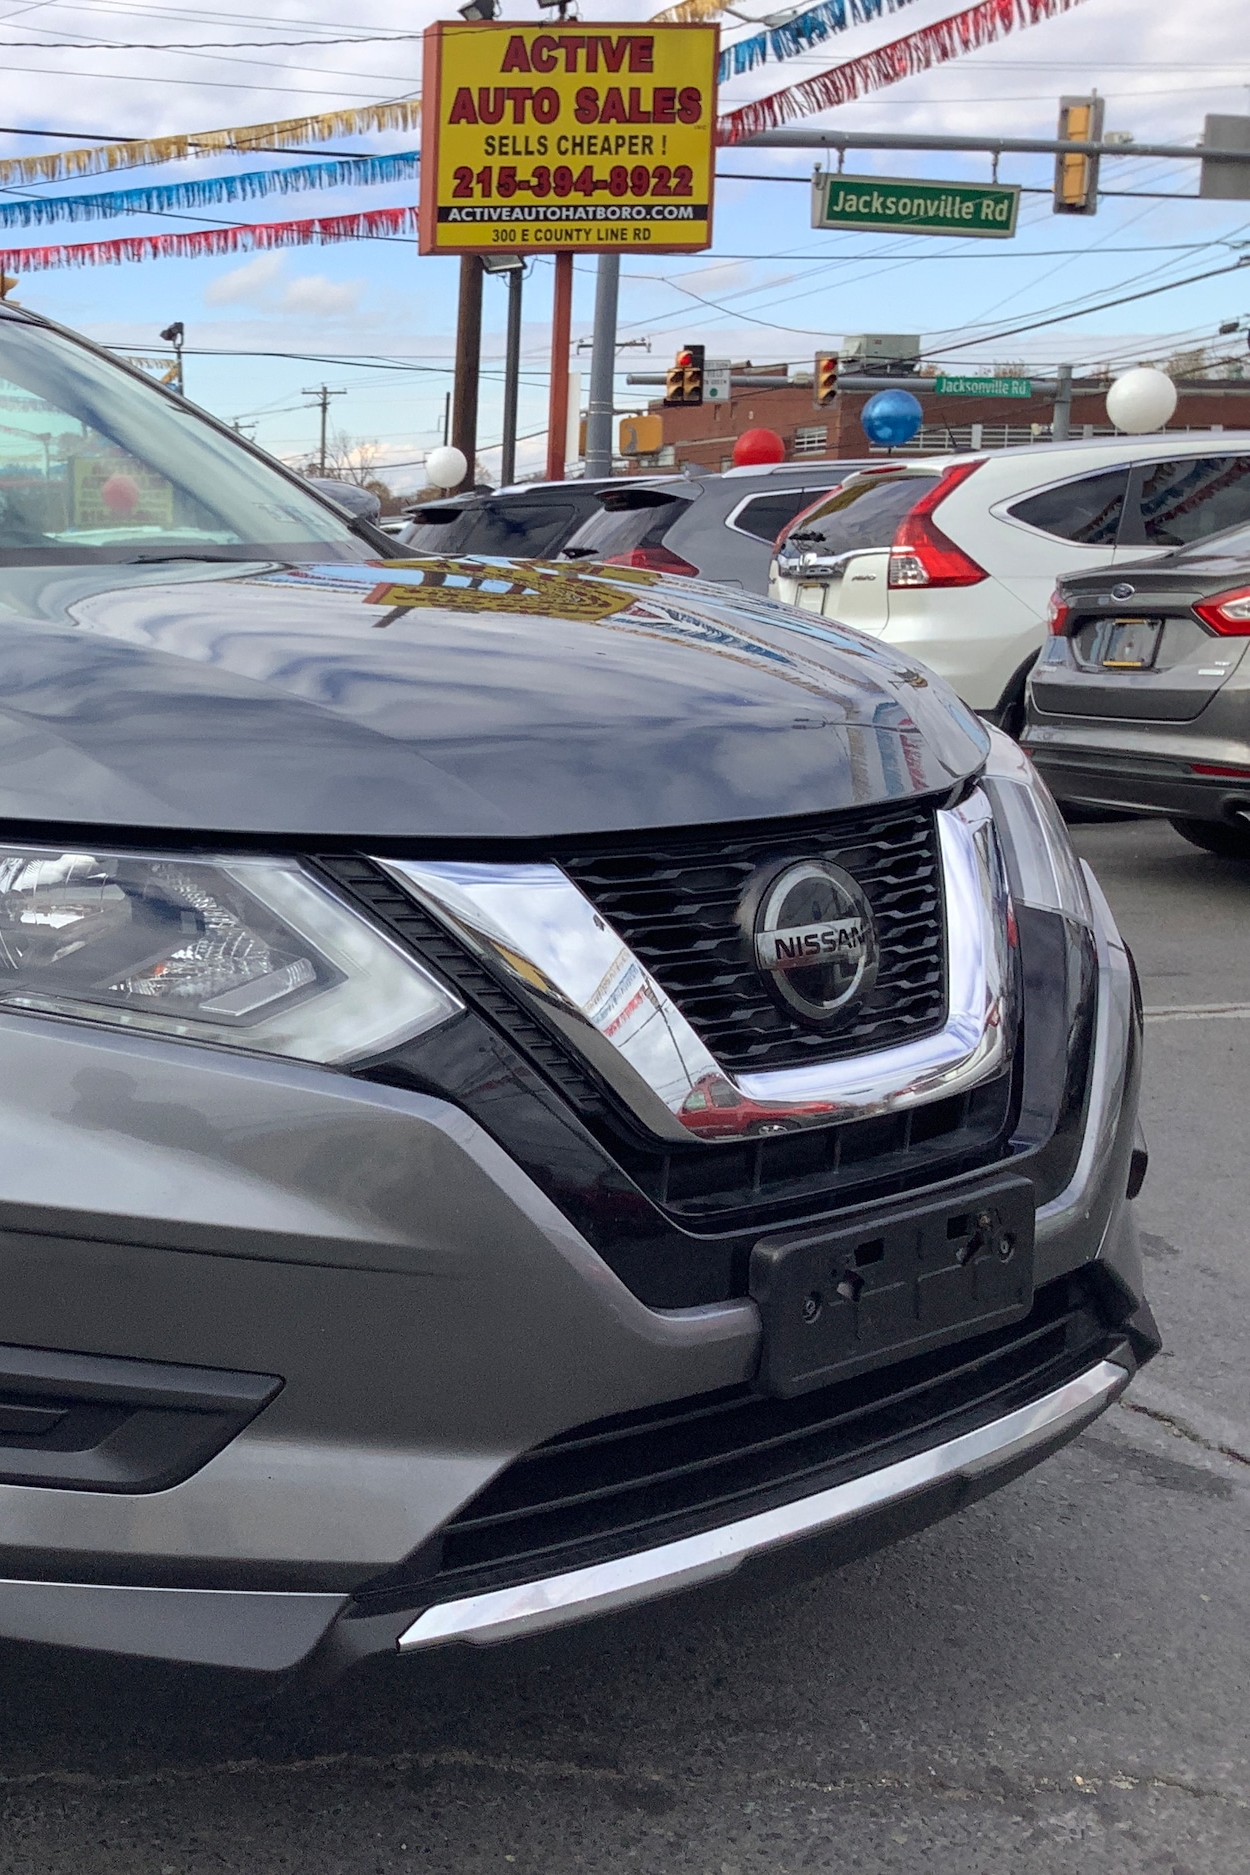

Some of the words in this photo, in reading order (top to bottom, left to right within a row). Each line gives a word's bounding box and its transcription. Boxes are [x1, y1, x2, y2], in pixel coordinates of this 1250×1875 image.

[500, 35, 655, 73] ACTIVE
[448, 86, 560, 125] AUTO
[574, 86, 703, 125] SALES
[484, 135, 549, 156] SELLS
[557, 135, 654, 156] CHEAPER
[452, 165, 693, 198] 215-394-8922
[448, 206, 694, 221] ACTIVEAUTOHATBORO.COM
[833, 190, 974, 219] Jacksonville
[980, 198, 1009, 222] Rd
[492, 228, 516, 242] 300
[521, 228, 530, 242] E
[534, 228, 593, 242] COUNTY
[597, 228, 628, 241] LINE
[633, 228, 652, 241] RD
[940, 378, 1009, 394] Jacksonville
[1011, 381, 1027, 395] Rd
[774, 924, 866, 960] NISSAN
